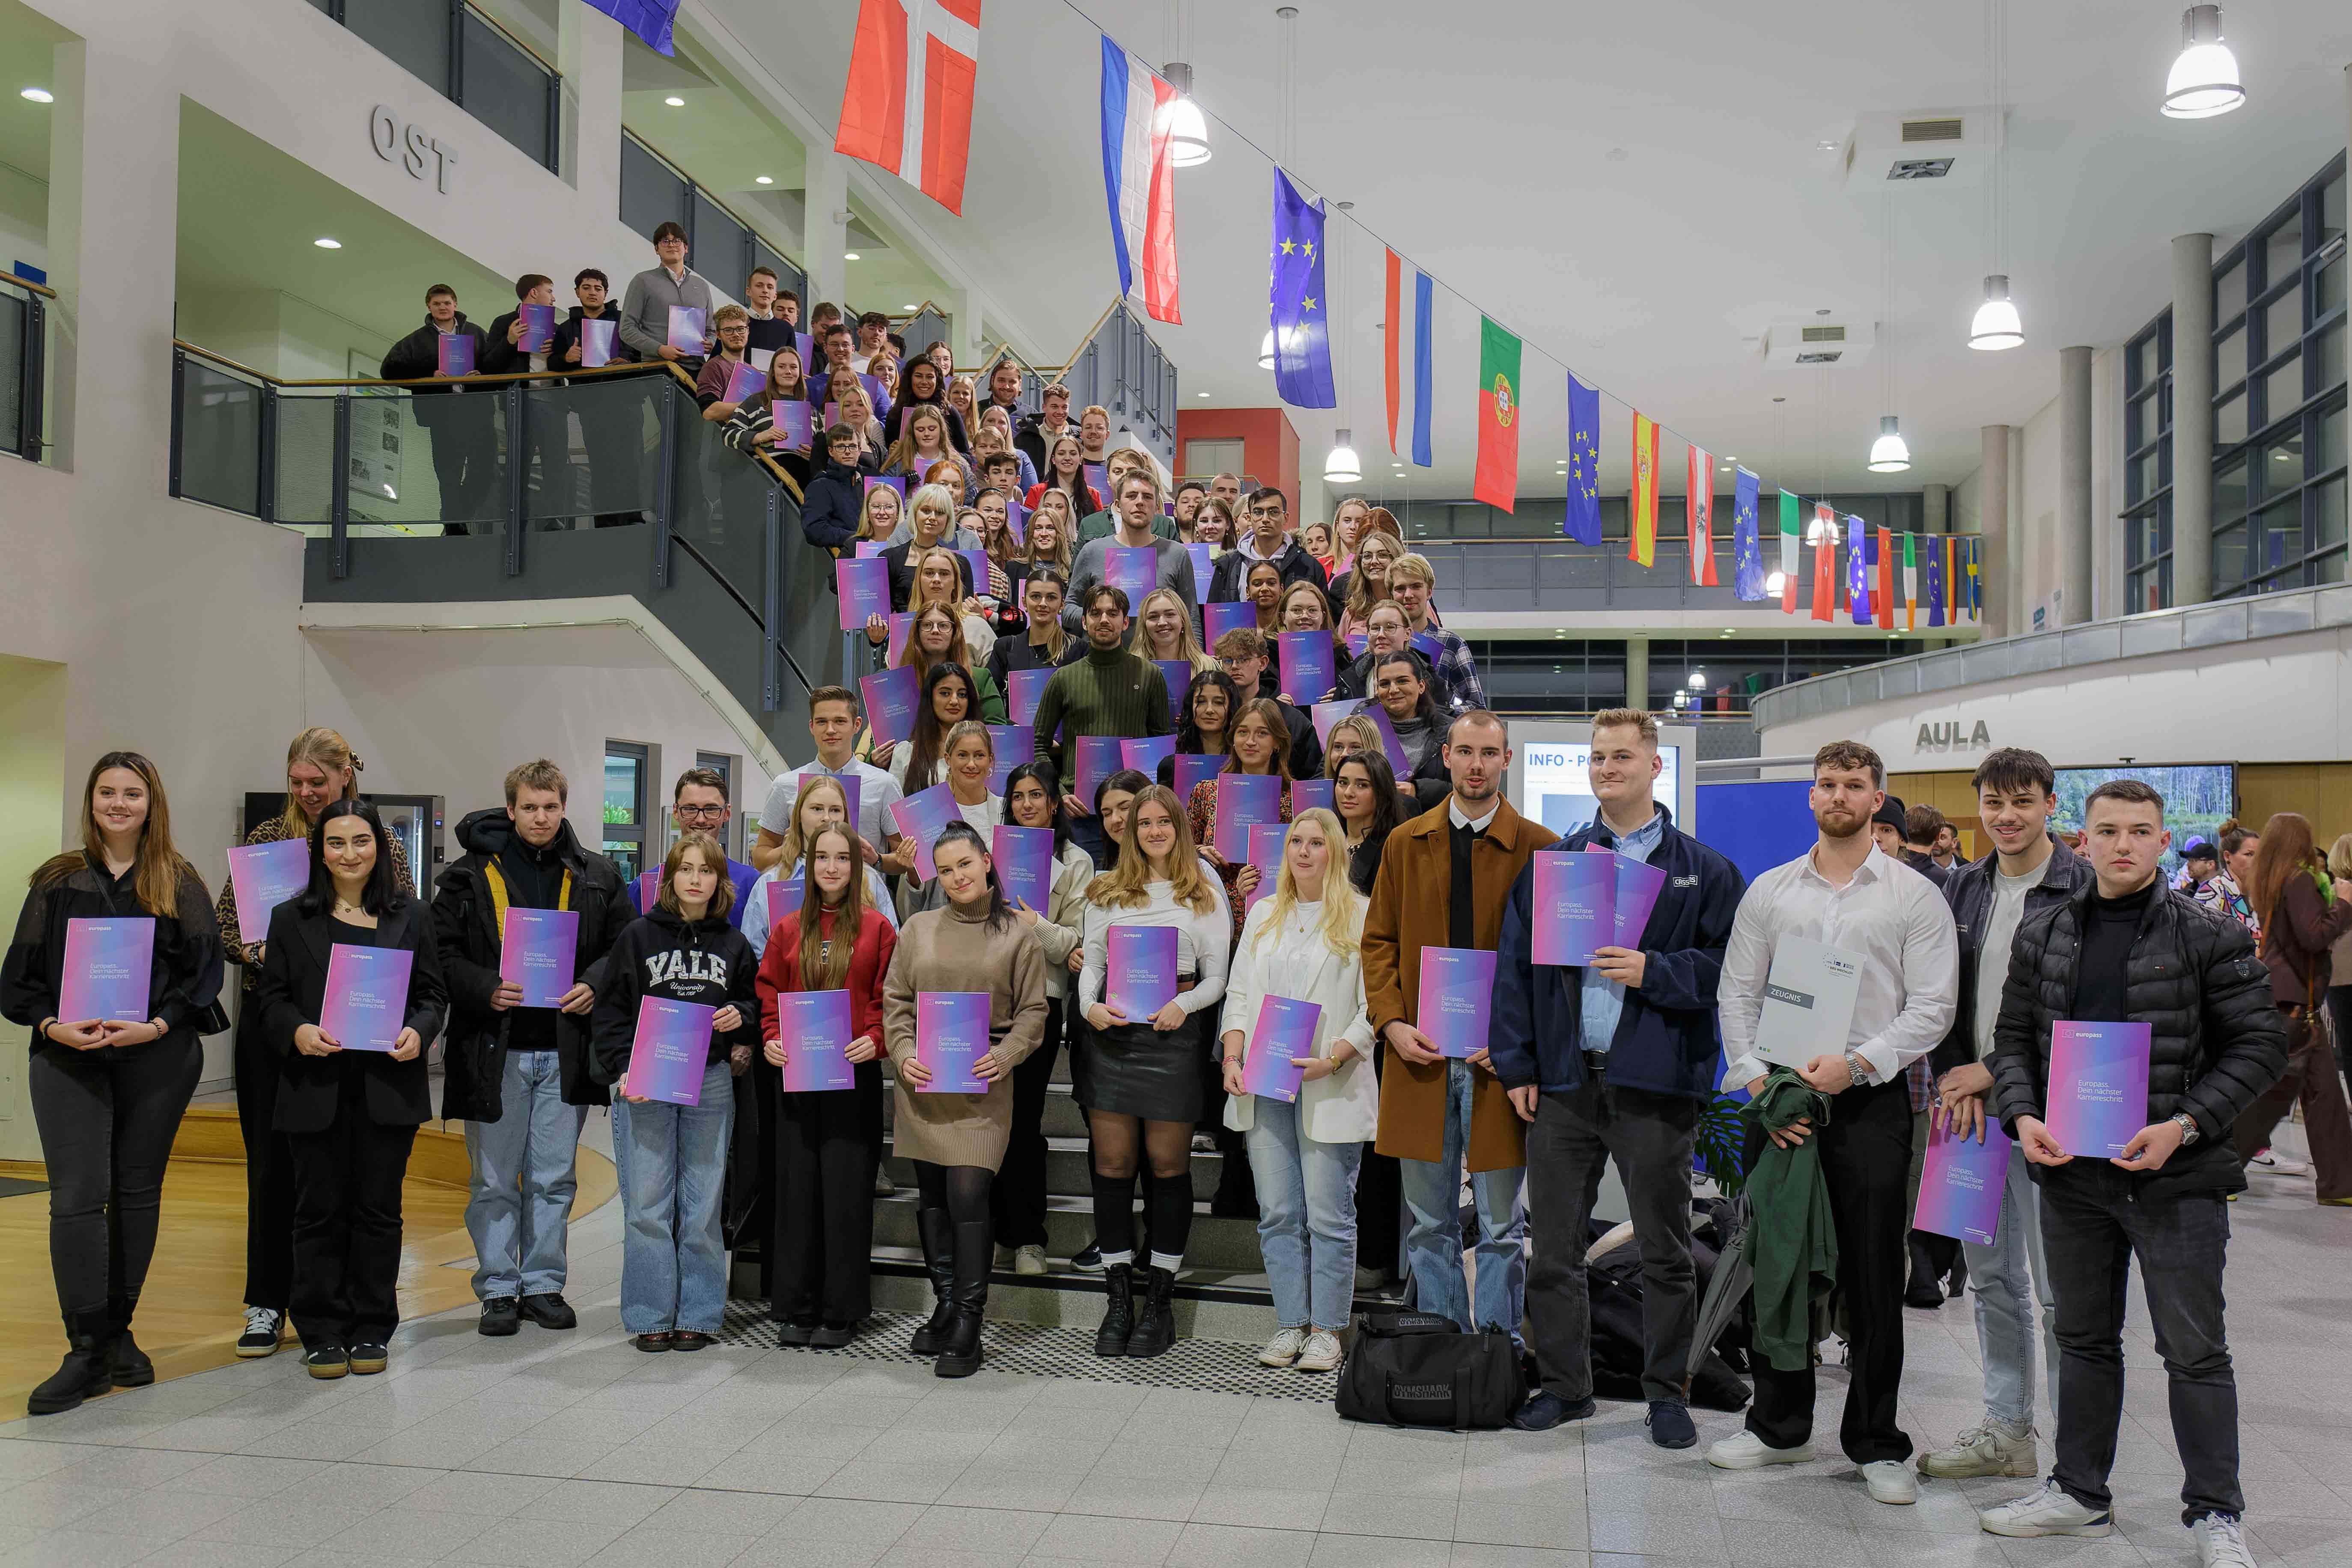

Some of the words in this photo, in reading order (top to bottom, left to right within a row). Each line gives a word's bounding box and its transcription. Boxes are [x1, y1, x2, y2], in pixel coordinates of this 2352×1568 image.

[371, 104, 458, 195] OST
[1917, 720, 1990, 745] AULA
[1529, 754, 1563, 766] INFO
[646, 949, 726, 988] YALE
[670, 982, 706, 992] University
[1771, 988, 1801, 1002] ZEUGNIS
[2078, 1080, 2110, 1089] Europass.
[2078, 1094, 2123, 1102] Karriereschritt
[1948, 1165, 1974, 1176] Europass.
[1947, 1179, 1984, 1190] Karriereschritt
[1394, 1384, 1452, 1400] GYMSHARK
